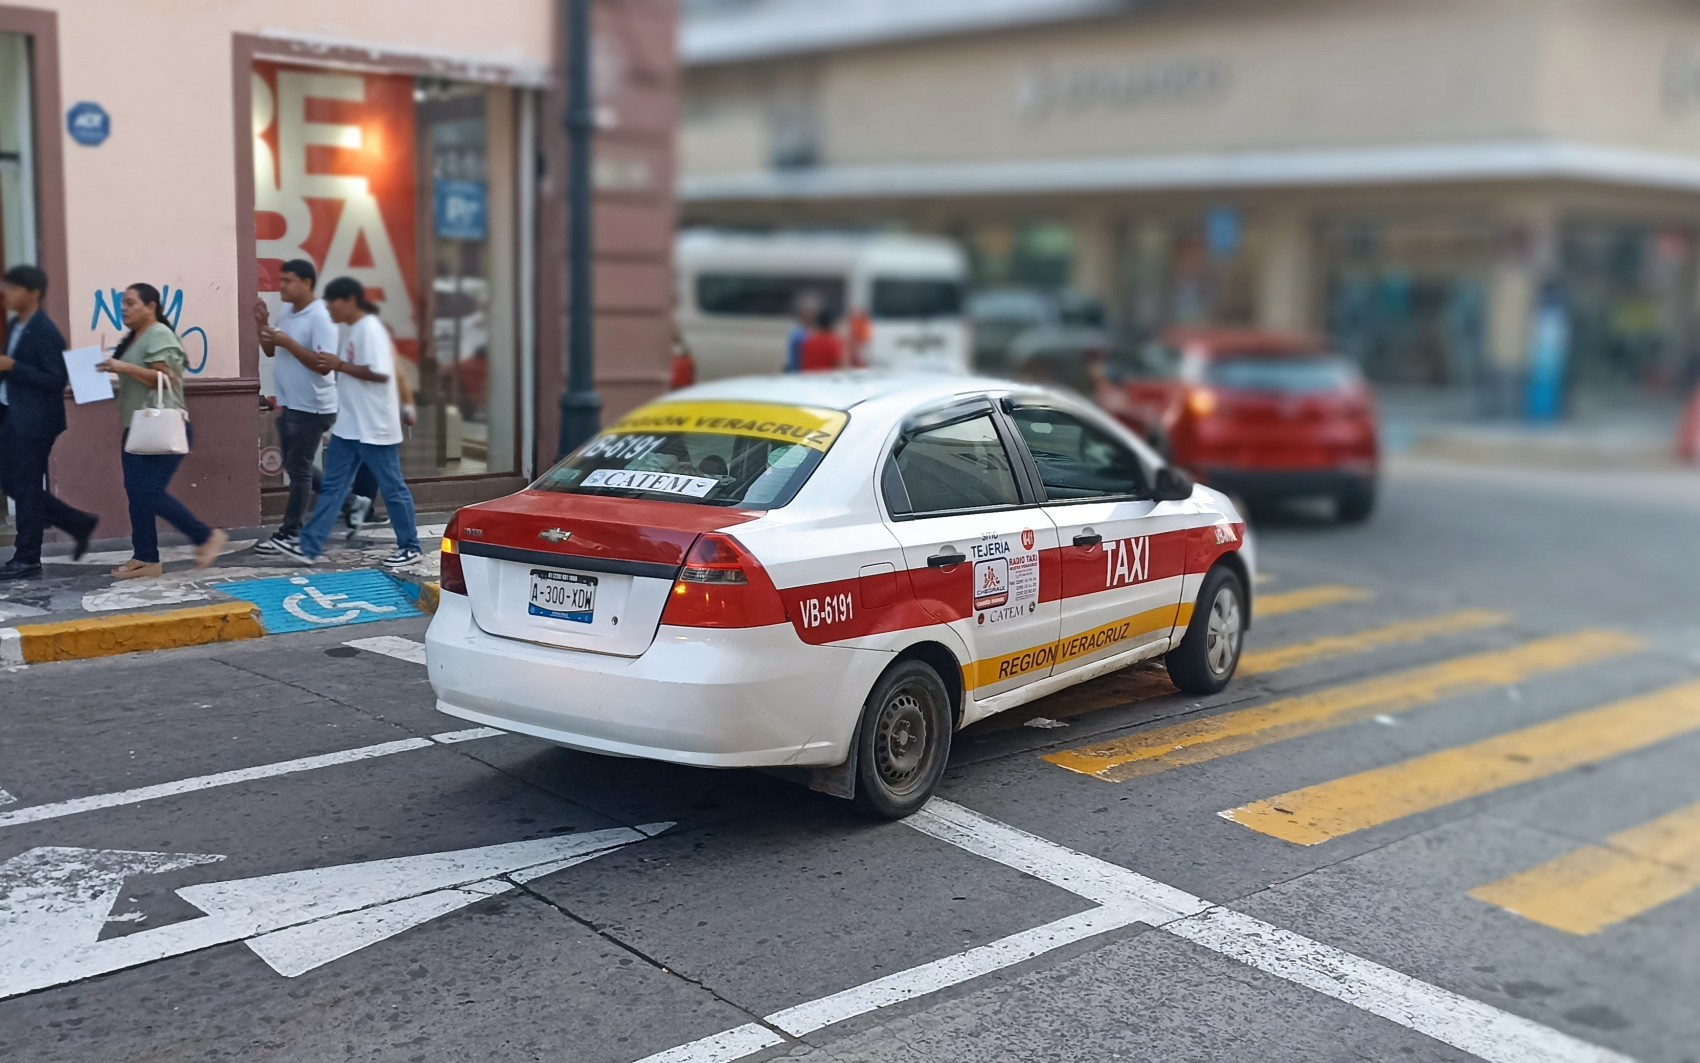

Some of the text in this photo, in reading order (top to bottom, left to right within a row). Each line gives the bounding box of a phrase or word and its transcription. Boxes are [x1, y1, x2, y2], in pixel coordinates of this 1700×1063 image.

[251, 71, 370, 199] E
[693, 416, 832, 445] VERACRUZ
[578, 436, 666, 461] VB-6191
[603, 471, 693, 493] CATEM
[971, 540, 1010, 558] TEJERÍA
[1026, 554, 1037, 563] TAXI
[1102, 536, 1150, 587] TAXI
[531, 583, 592, 609] A-300-XDW
[799, 592, 854, 629] VB-6191
[990, 605, 1024, 623] CATEM
[998, 622, 1131, 679] REGION VERACRUZ
